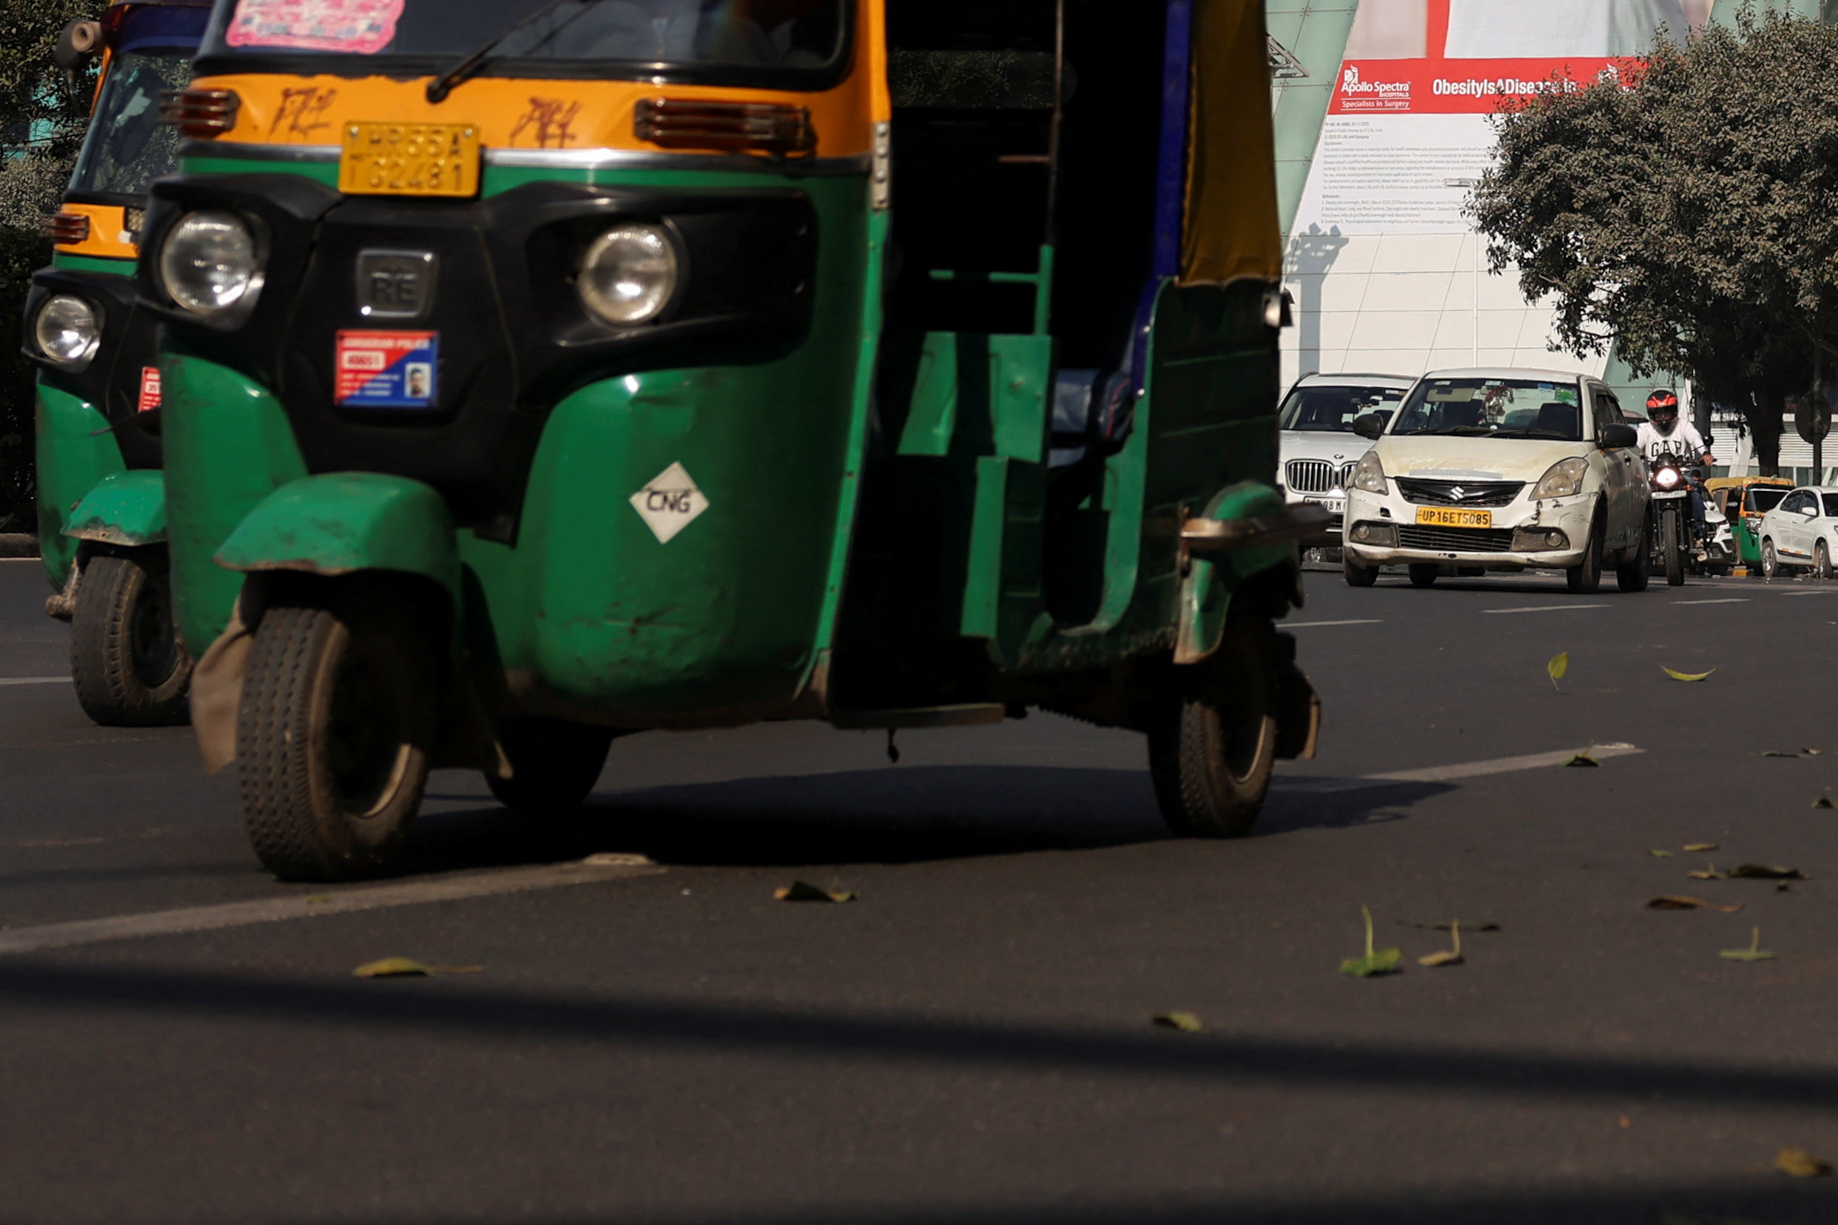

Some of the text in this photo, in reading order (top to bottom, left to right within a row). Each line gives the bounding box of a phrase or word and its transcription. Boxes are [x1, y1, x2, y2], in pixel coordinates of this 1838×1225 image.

[1341, 81, 1373, 96] Apollo
[1433, 78, 1577, 98] ObesityIsADiseasein
[1342, 100, 1375, 109] Specialists
[1384, 100, 1410, 109] Surgery
[1651, 440, 1682, 458] GAP
[647, 489, 691, 513] CNG
[1422, 510, 1489, 525] UP16ET5085
